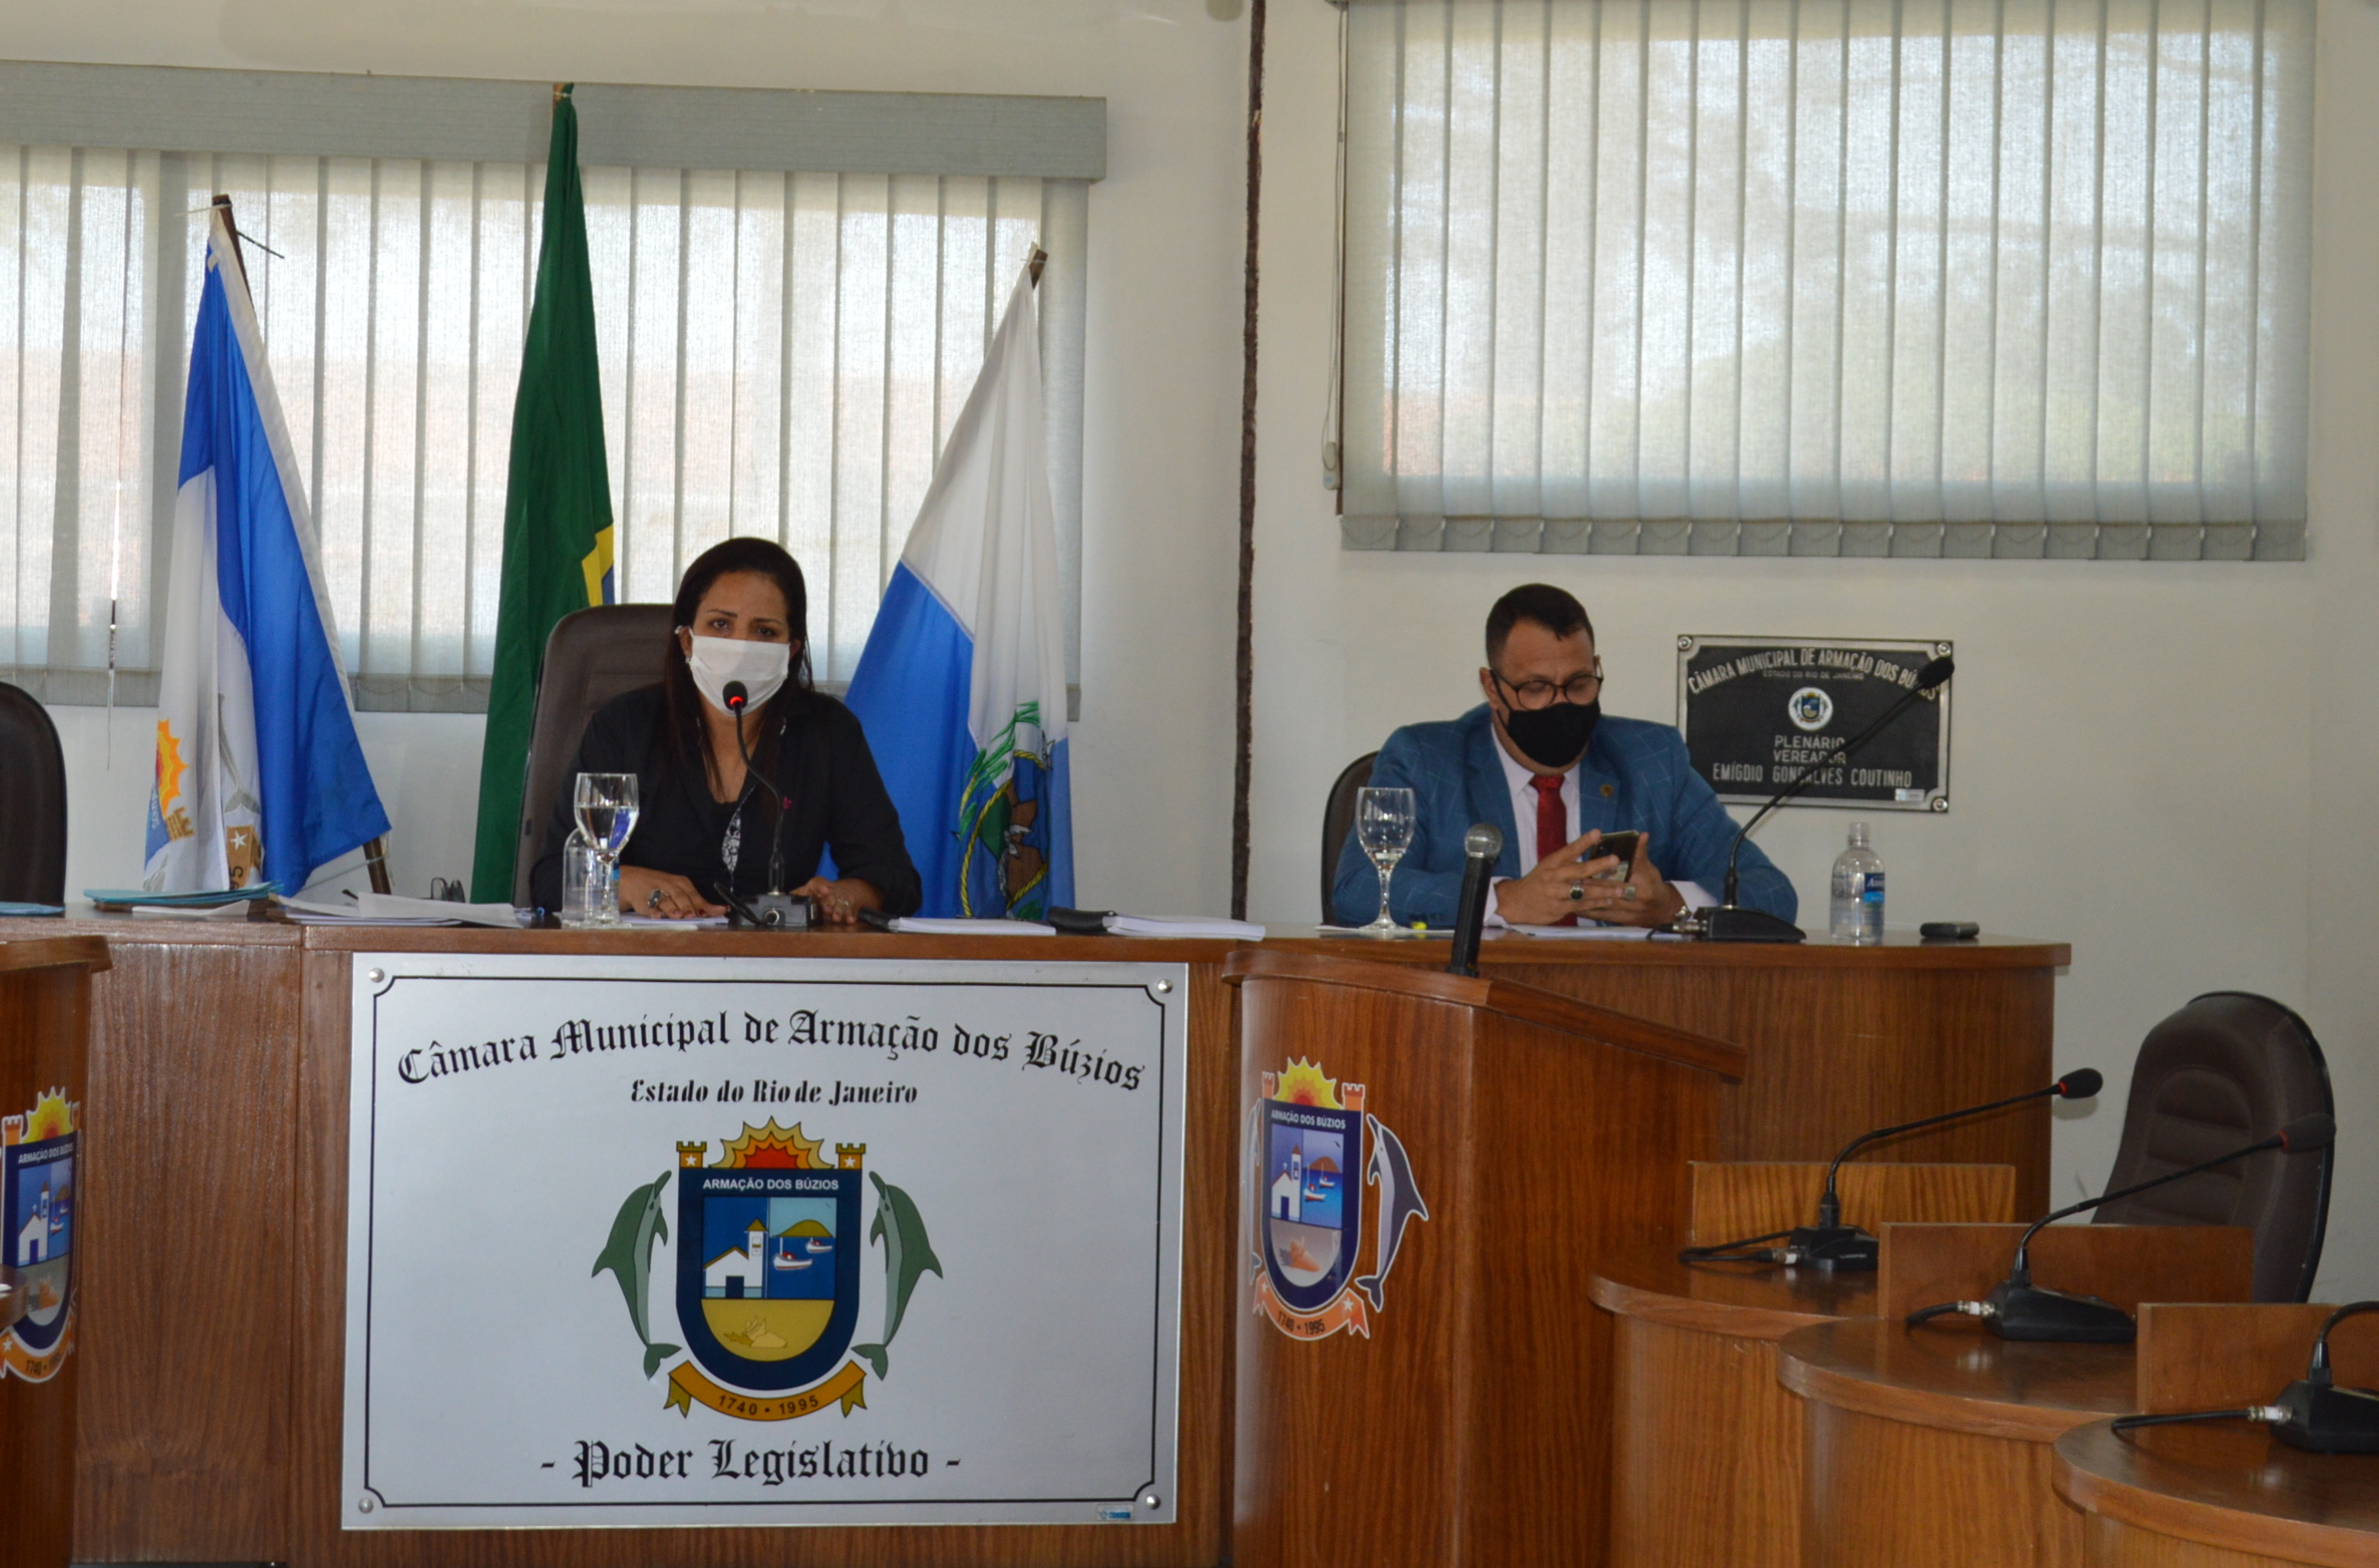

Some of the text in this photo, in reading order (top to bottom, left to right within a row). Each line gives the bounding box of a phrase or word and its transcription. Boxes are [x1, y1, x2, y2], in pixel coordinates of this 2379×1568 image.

[1687, 662, 1736, 694] CÂMARA
[1735, 649, 1798, 678] MUNICIPAL
[1800, 648, 1816, 665] DE
[1817, 650, 1874, 675] ARMAÇÃO
[1873, 663, 1900, 682] DOS
[1774, 734, 1845, 749] PLENÁRIO
[1713, 761, 1763, 782] EMÍGDIO
[1851, 768, 1912, 788] COUTINHO
[397, 1008, 1147, 1092] Câmara Municipal de Armação dos Búzios
[630, 1079, 918, 1107] Estado do Rio de Janeiro
[1300, 1114, 1315, 1126] DOS
[1316, 1115, 1346, 1130] BÚZIOS
[702, 1177, 839, 1192] ARMAÇÃO DOS BÚZIOS
[718, 1395, 819, 1415] 1740 1995
[571, 1439, 693, 1488] Poder
[708, 1438, 929, 1487] Legislativo
